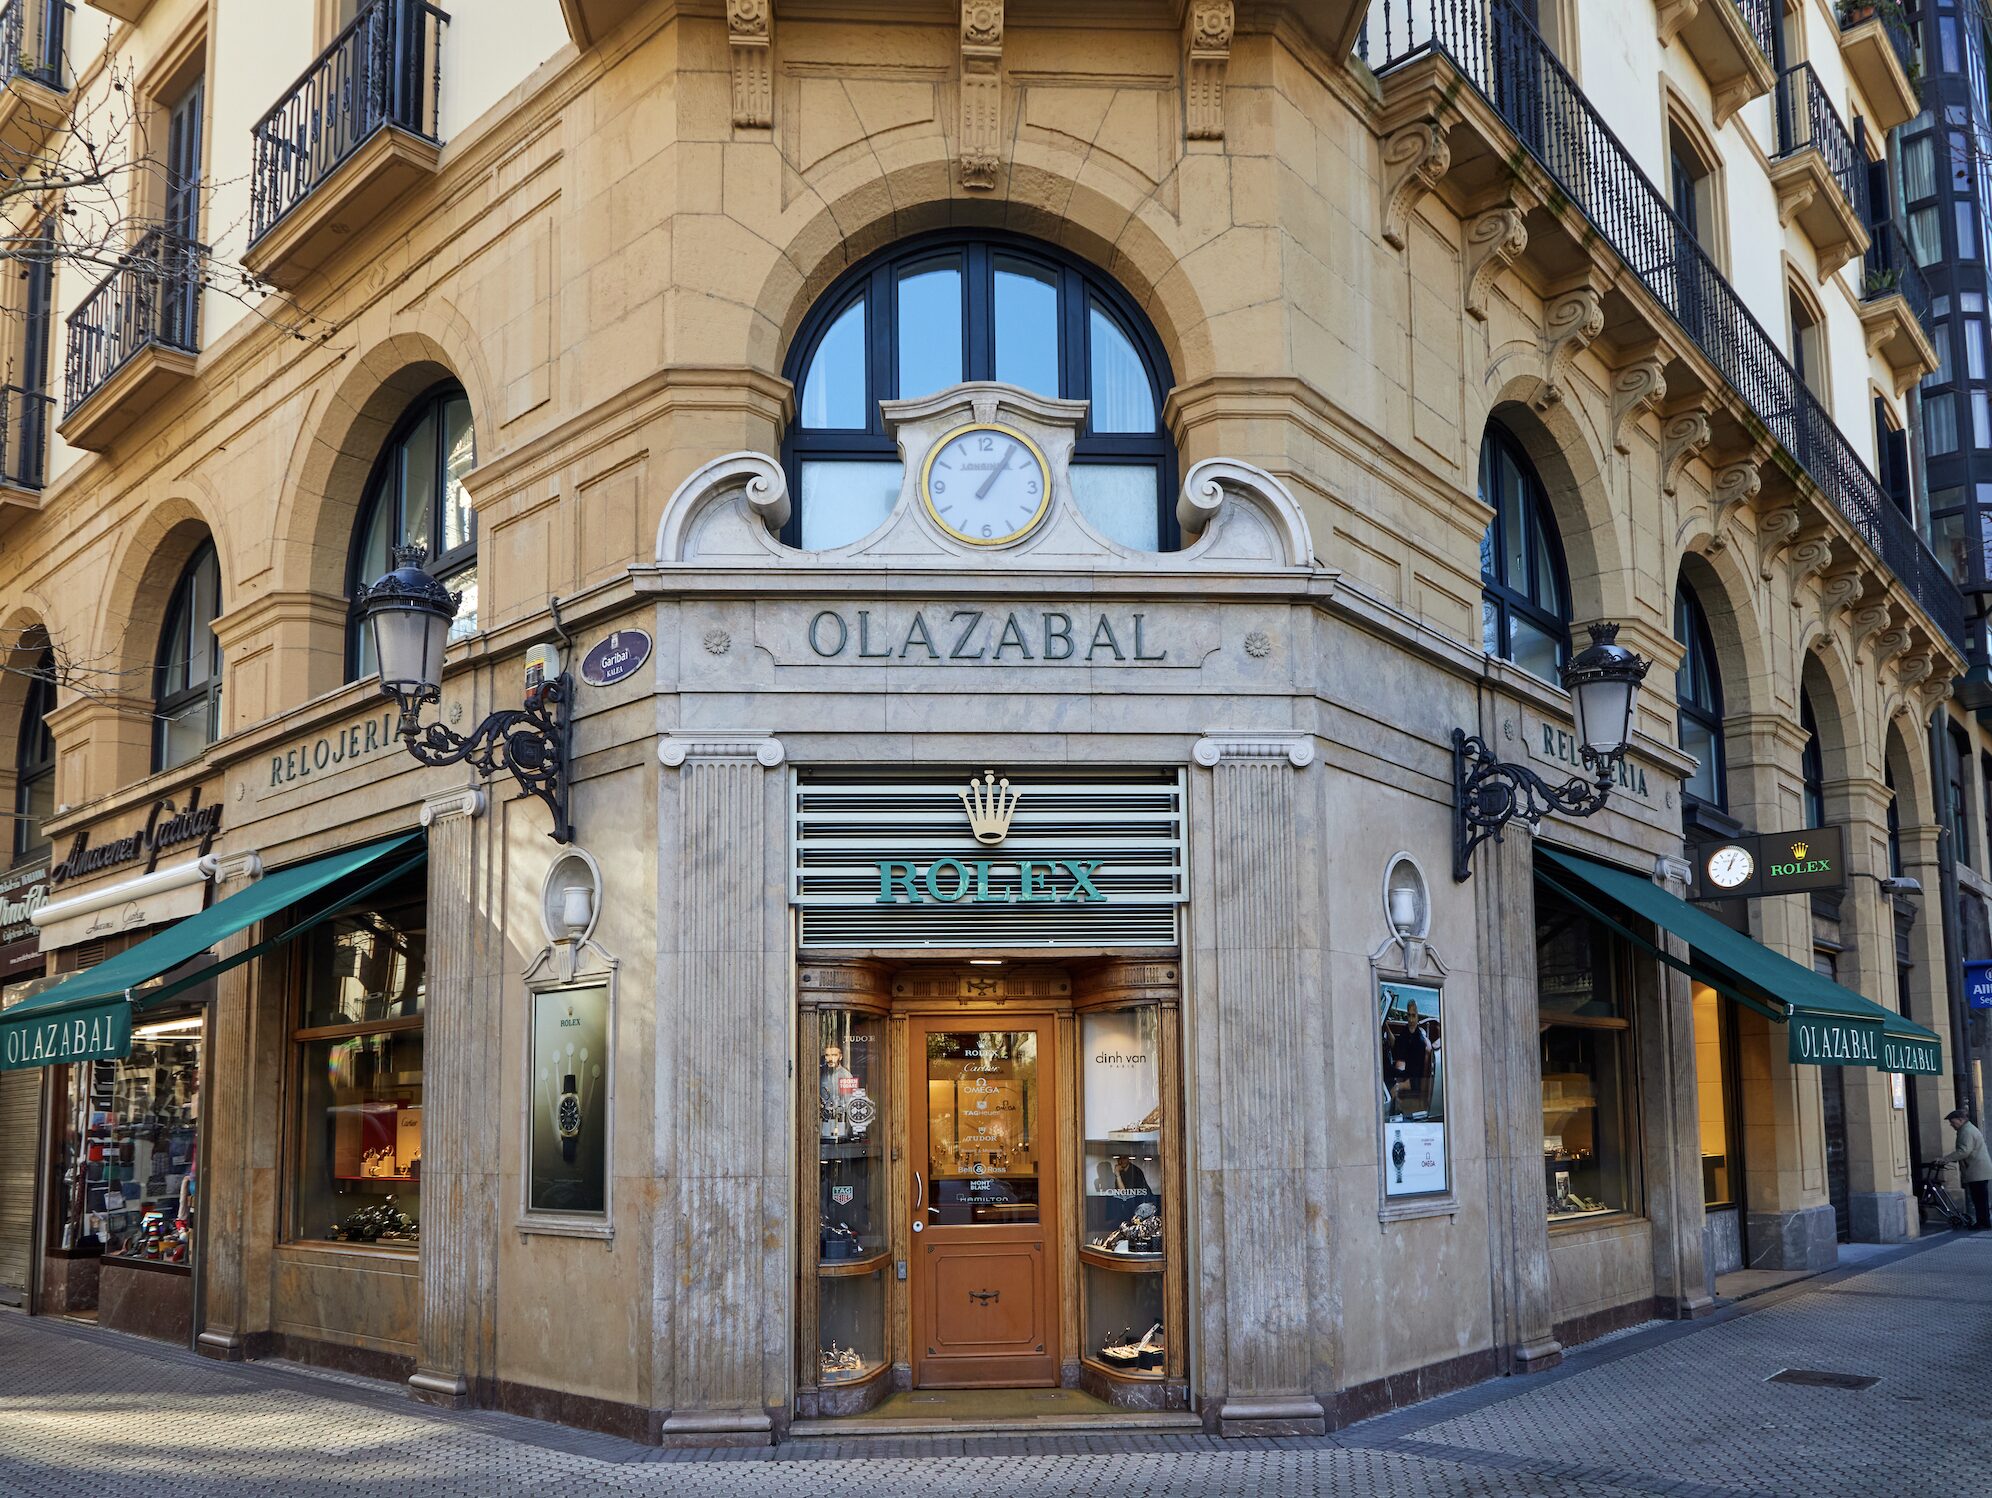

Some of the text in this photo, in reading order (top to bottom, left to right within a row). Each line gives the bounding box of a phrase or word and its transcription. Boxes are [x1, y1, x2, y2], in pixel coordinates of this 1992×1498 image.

[977, 437, 994, 452] 12
[934, 480, 946, 494] 9
[1026, 480, 1038, 495] 3
[981, 524, 992, 538] 6
[808, 610, 1167, 660] OLAZABAL
[601, 648, 628, 669] Garibai
[606, 666, 624, 678] KALEA
[143, 786, 224, 876] Garibay
[1770, 859, 1832, 877] ROLEX
[875, 857, 1108, 903] ROLEX
[1972, 984, 1992, 995] All
[560, 1018, 581, 1027] ROLEX
[7, 1015, 116, 1064] OLAZABAL
[844, 1035, 876, 1043] TUDOR
[1800, 1025, 1878, 1060] OLAZABAL
[964, 1049, 999, 1057] ROLEX
[1095, 1051, 1147, 1064] dinh van
[1884, 1044, 1938, 1072] OLAZABAL
[963, 1062, 1001, 1073] Cartier
[963, 1086, 1000, 1094] OMEGA
[401, 1117, 418, 1127] Cartier
[1420, 1160, 1436, 1168] OMEGA
[1099, 1188, 1148, 1196] LONGINES
